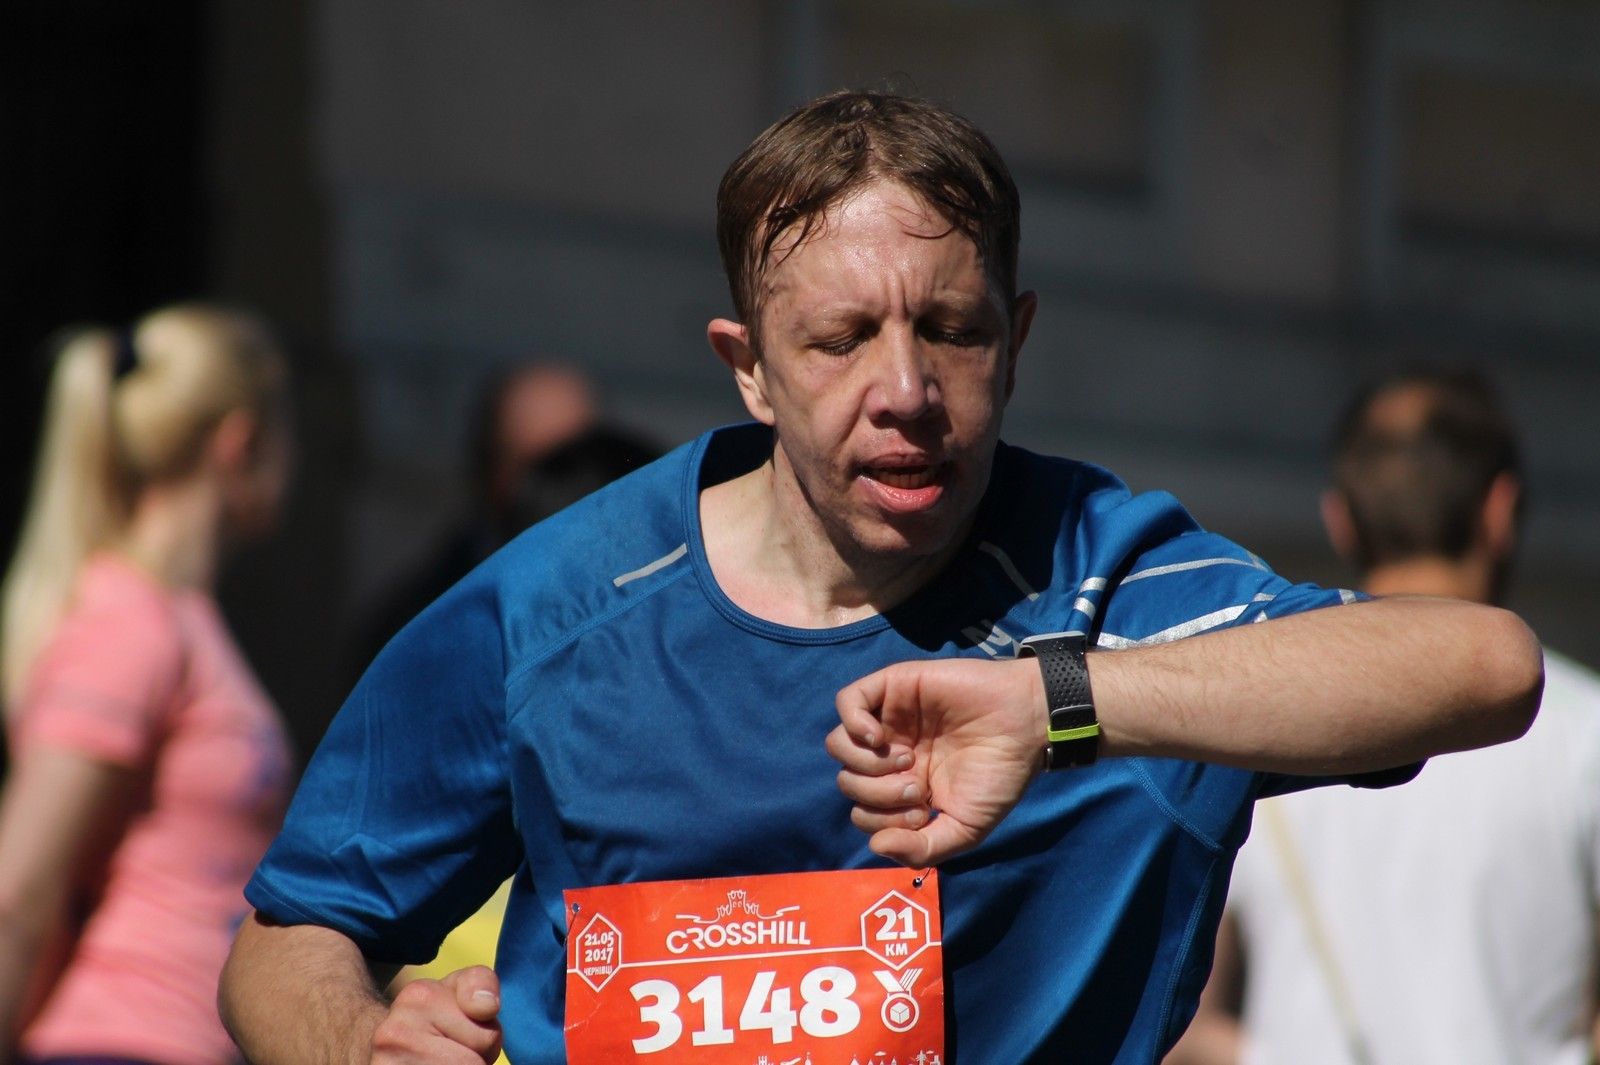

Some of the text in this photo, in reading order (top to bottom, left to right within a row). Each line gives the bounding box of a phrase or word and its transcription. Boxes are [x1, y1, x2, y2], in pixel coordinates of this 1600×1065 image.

[584, 931, 614, 947] 21.05
[666, 921, 811, 954] CROSSHILL
[875, 906, 918, 941] 21
[585, 948, 613, 964] 2017
[629, 966, 861, 1054] 3148
